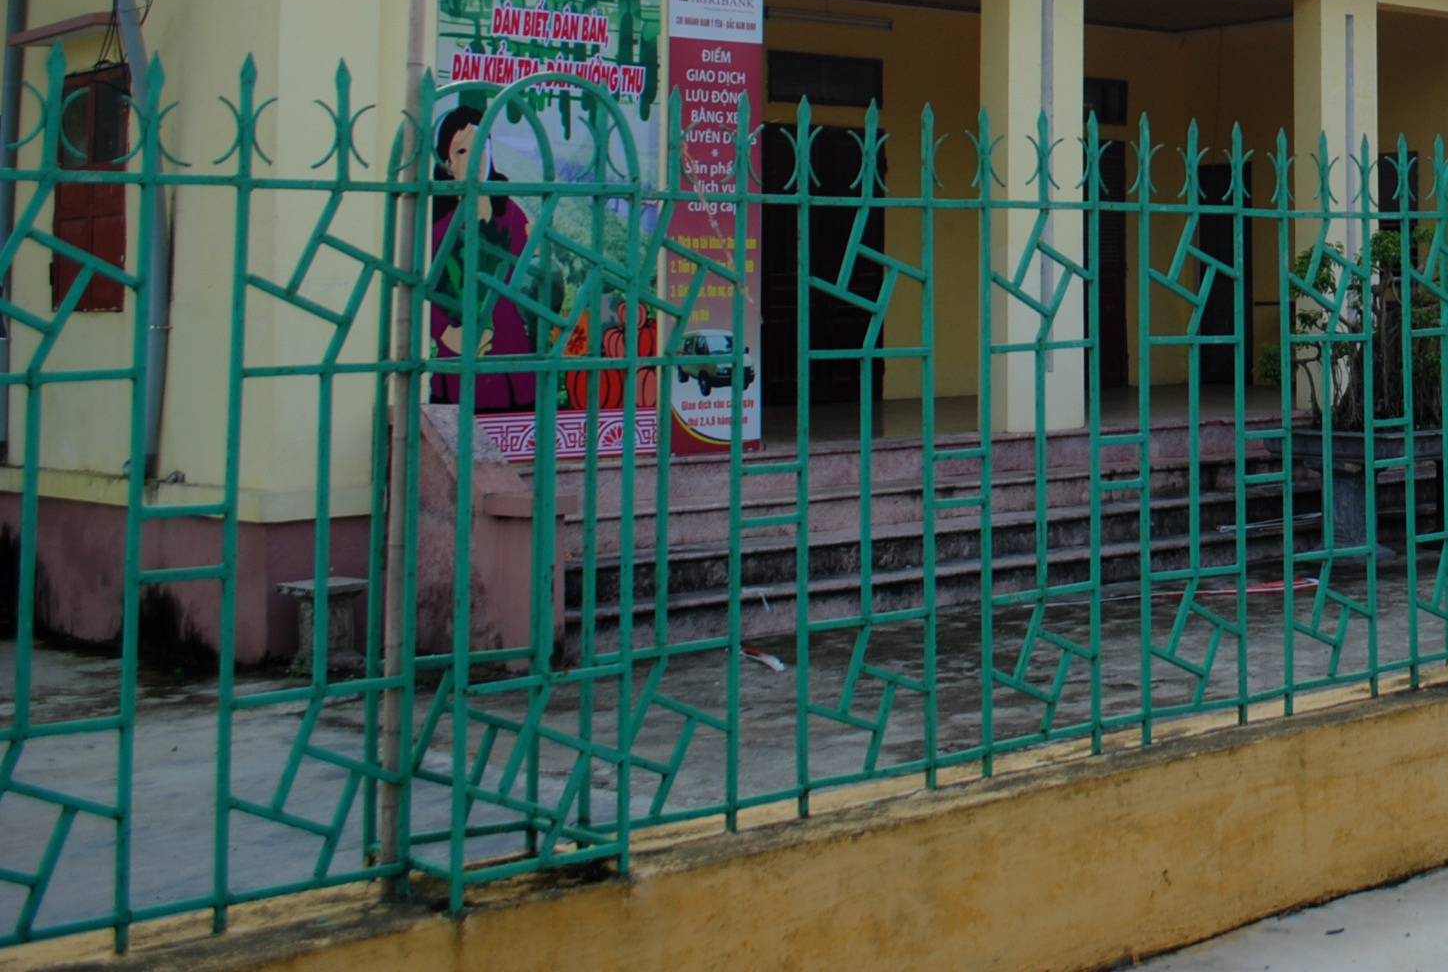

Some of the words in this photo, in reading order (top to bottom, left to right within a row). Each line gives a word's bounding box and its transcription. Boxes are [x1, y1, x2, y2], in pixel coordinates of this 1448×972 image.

[493, 0, 521, 35] DÂN
[553, 4, 579, 41] DÂN
[702, 46, 731, 63] ĐIỂM
[453, 47, 480, 82] DÂN
[483, 41, 514, 84] KIỂM
[622, 68, 645, 101] THỤ
[686, 68, 715, 83] GIAO
[718, 71, 746, 86] DỊCH
[685, 88, 710, 103] LƯU
[680, 128, 720, 144] HUYÊN
[710, 159, 734, 178] phẩ
